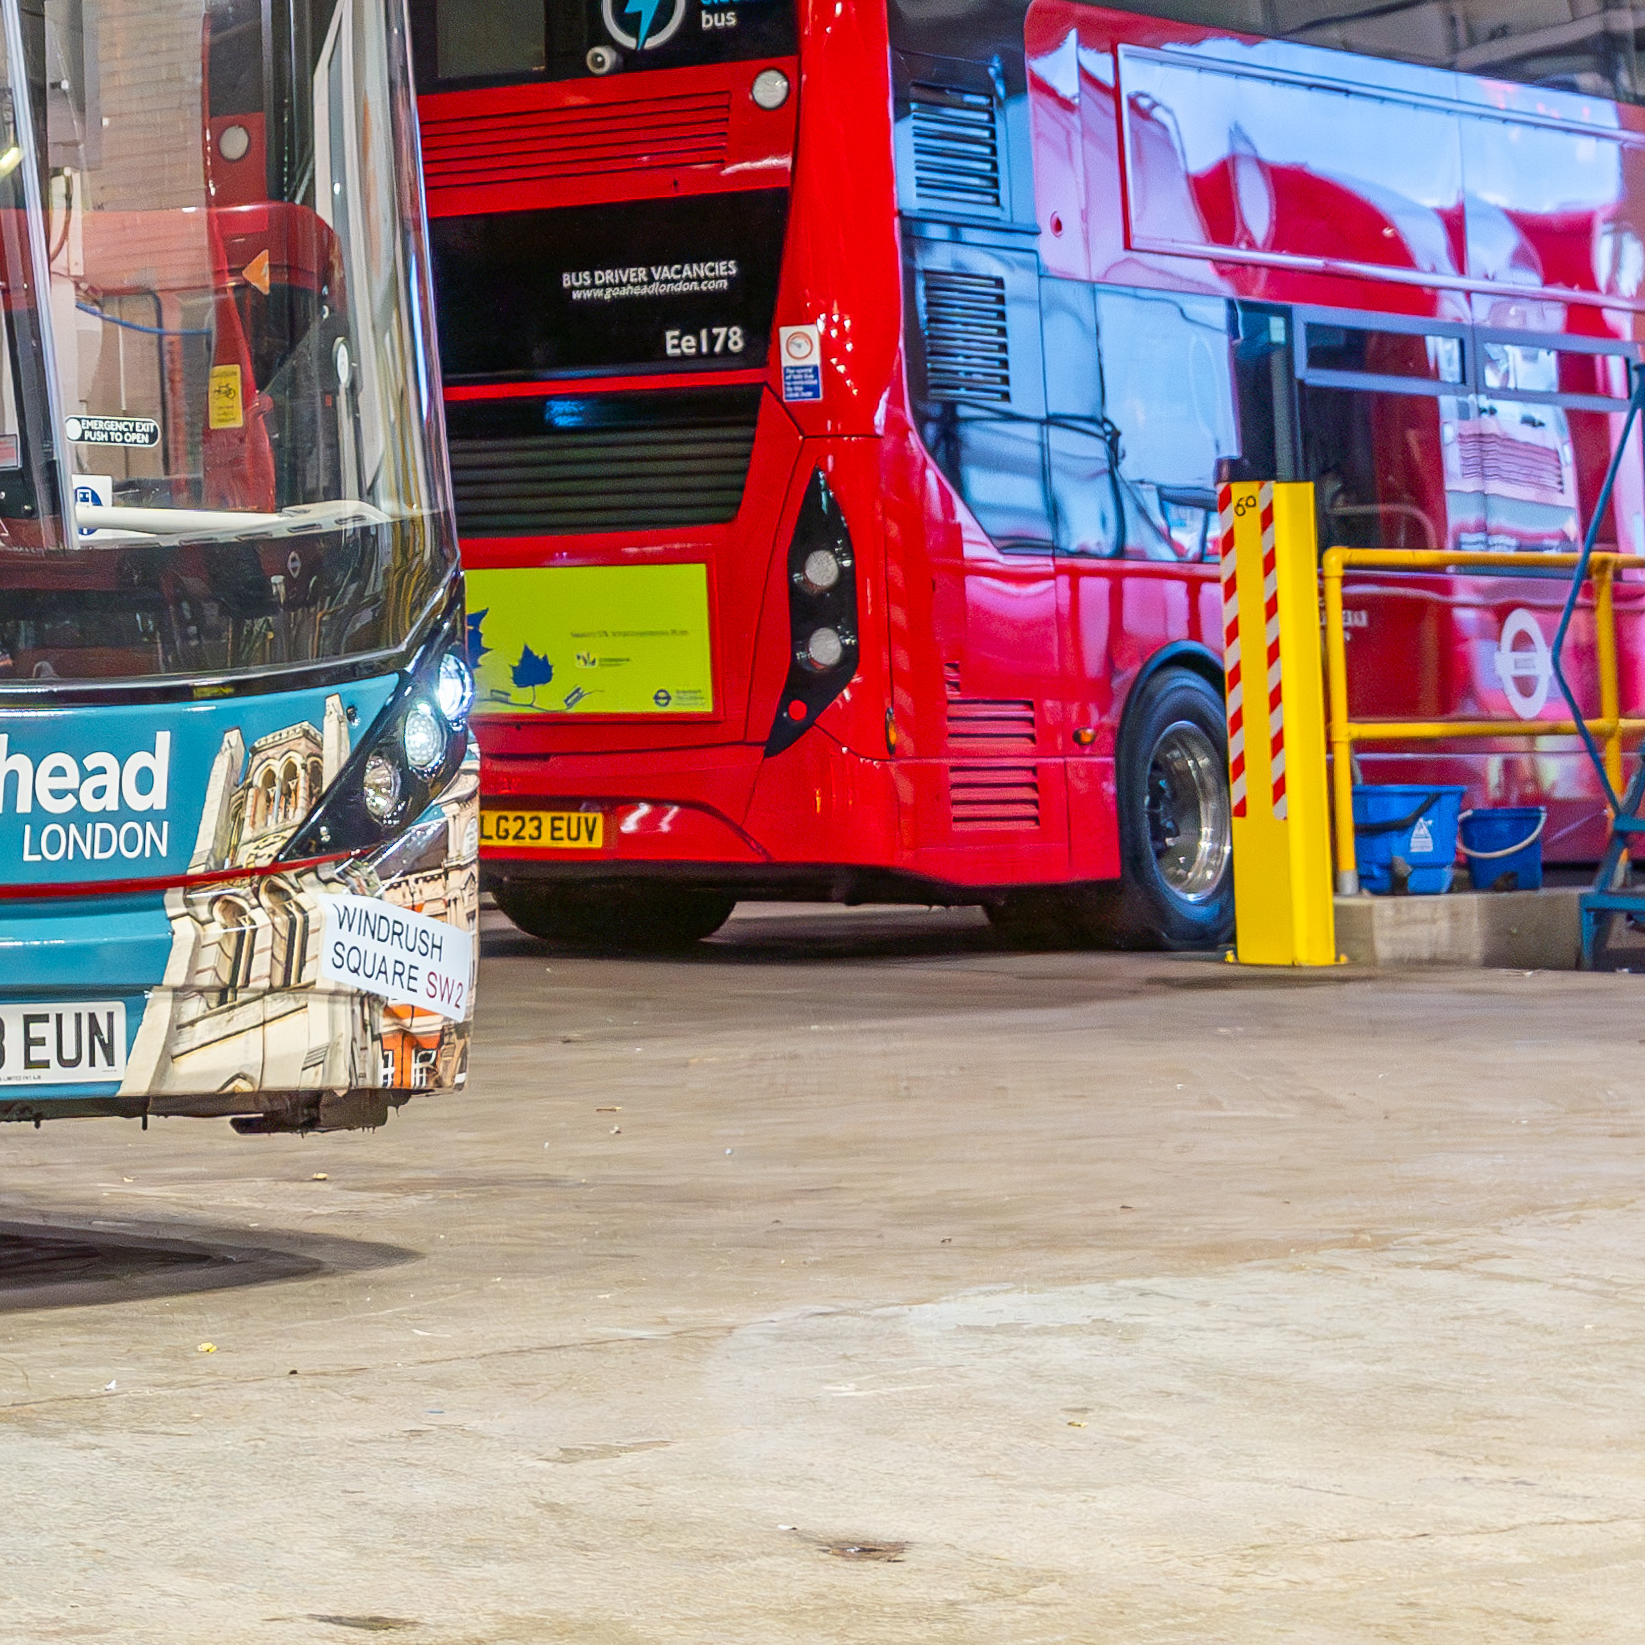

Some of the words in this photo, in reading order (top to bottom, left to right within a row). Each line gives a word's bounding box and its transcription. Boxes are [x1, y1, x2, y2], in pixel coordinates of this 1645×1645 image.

[701, 10, 737, 31] bus
[562, 271, 593, 288] BUS
[594, 267, 648, 286] DRIVER
[649, 260, 740, 281] VACANCIES
[571, 278, 728, 301] www.goaheadlondon.com
[664, 325, 745, 357] Ee178
[81, 419, 134, 432] EMERGENCY
[135, 422, 154, 433] EXIT
[84, 431, 108, 442] PUSH
[109, 432, 123, 443] TO
[124, 433, 150, 444] OPEN
[22, 820, 169, 863] LONDON
[480, 815, 543, 841] LG23
[550, 816, 597, 842] EUV
[332, 902, 444, 963] WINDRUSH
[331, 940, 420, 994] SQUARE
[425, 971, 465, 1010] SW2
[22, 1010, 116, 1070] EUN
